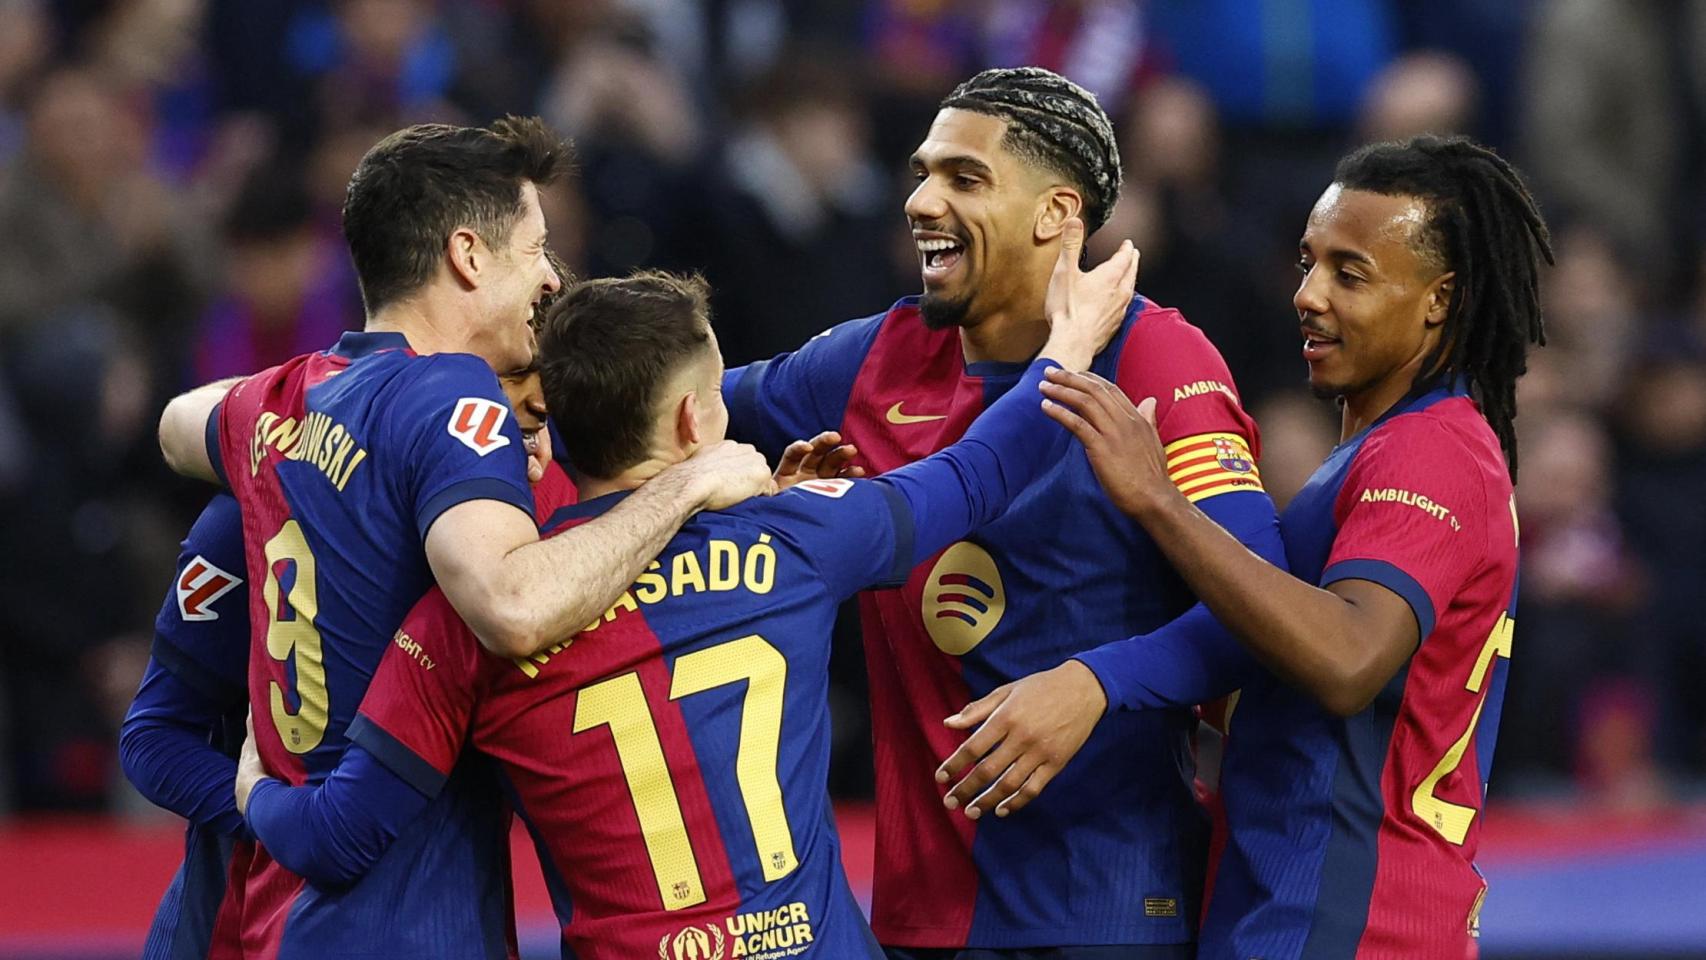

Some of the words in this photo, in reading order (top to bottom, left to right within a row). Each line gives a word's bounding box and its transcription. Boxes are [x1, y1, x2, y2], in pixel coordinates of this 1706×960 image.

[1360, 488, 1450, 521] AMBILIGHT
[263, 519, 329, 755] 9
[420, 654, 436, 670] tv
[572, 633, 800, 912] 17
[726, 902, 810, 936] UNHCR
[732, 923, 814, 958] ACNUR
